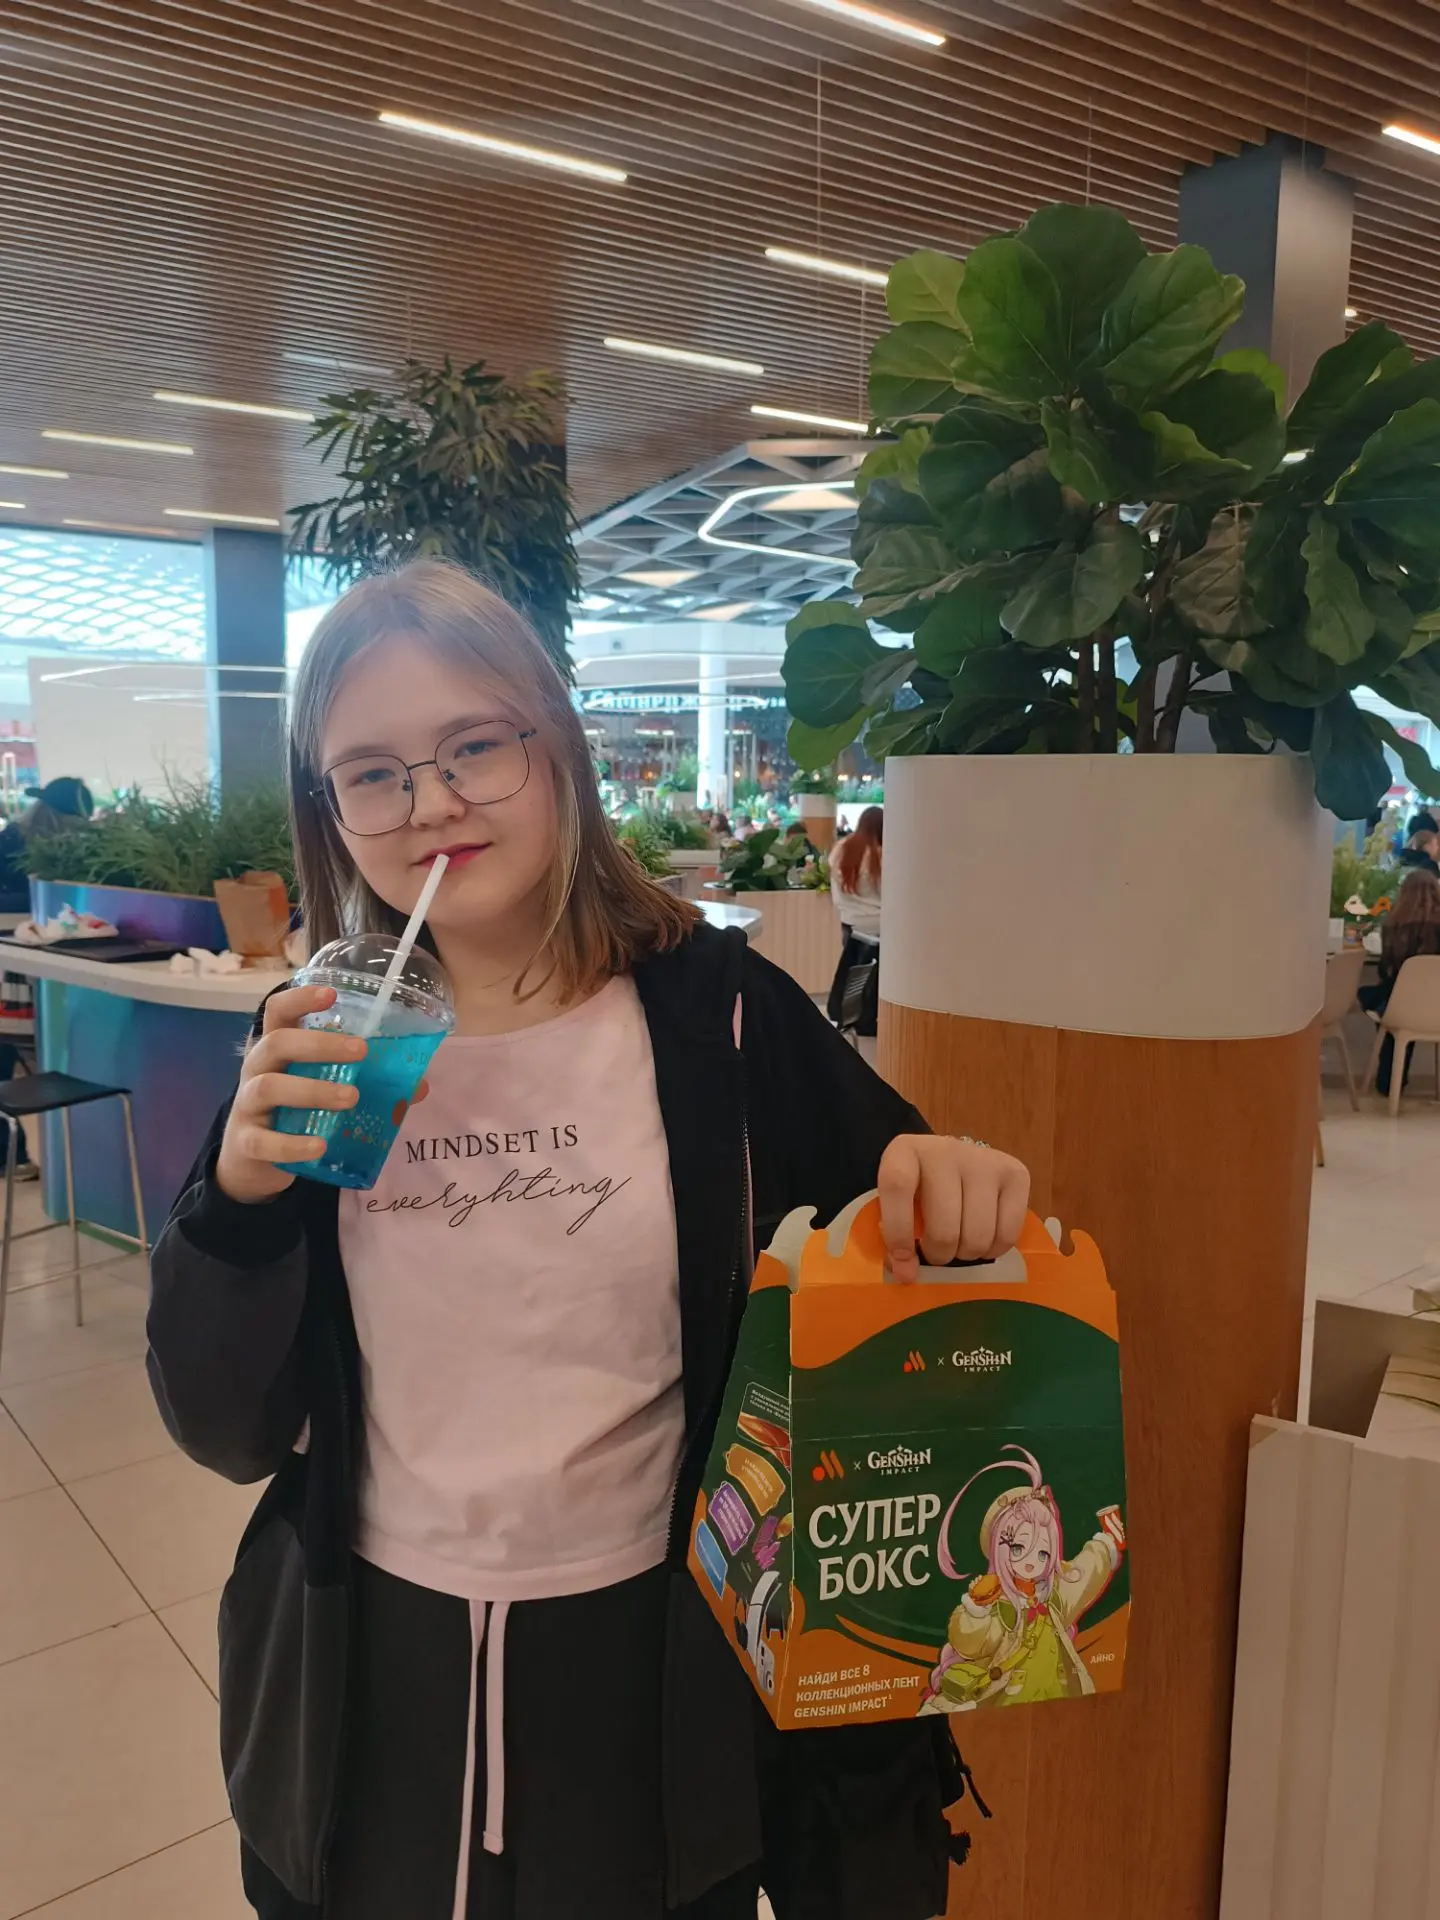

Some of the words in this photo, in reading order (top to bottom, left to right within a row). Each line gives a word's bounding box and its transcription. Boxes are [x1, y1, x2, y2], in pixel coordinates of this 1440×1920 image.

[405, 1130, 539, 1164] MINDSET
[550, 1124, 579, 1149] IS
[952, 1346, 1012, 1367] GENSHIN
[867, 1444, 932, 1470] GENSHIN
[881, 1466, 921, 1476] IMPACT
[808, 1493, 942, 1549] СУПЕР
[818, 1544, 931, 1601] БОКС
[1090, 1652, 1116, 1664] АЙНО
[798, 1671, 838, 1687] НАЙДИ
[840, 1667, 861, 1681] ВСЕ
[862, 1664, 871, 1676] 8
[796, 1679, 891, 1703] КОЛЛЕКЦИОННЫХ
[892, 1676, 920, 1689] ЛЕНТ
[793, 1703, 846, 1718] GENSHIN
